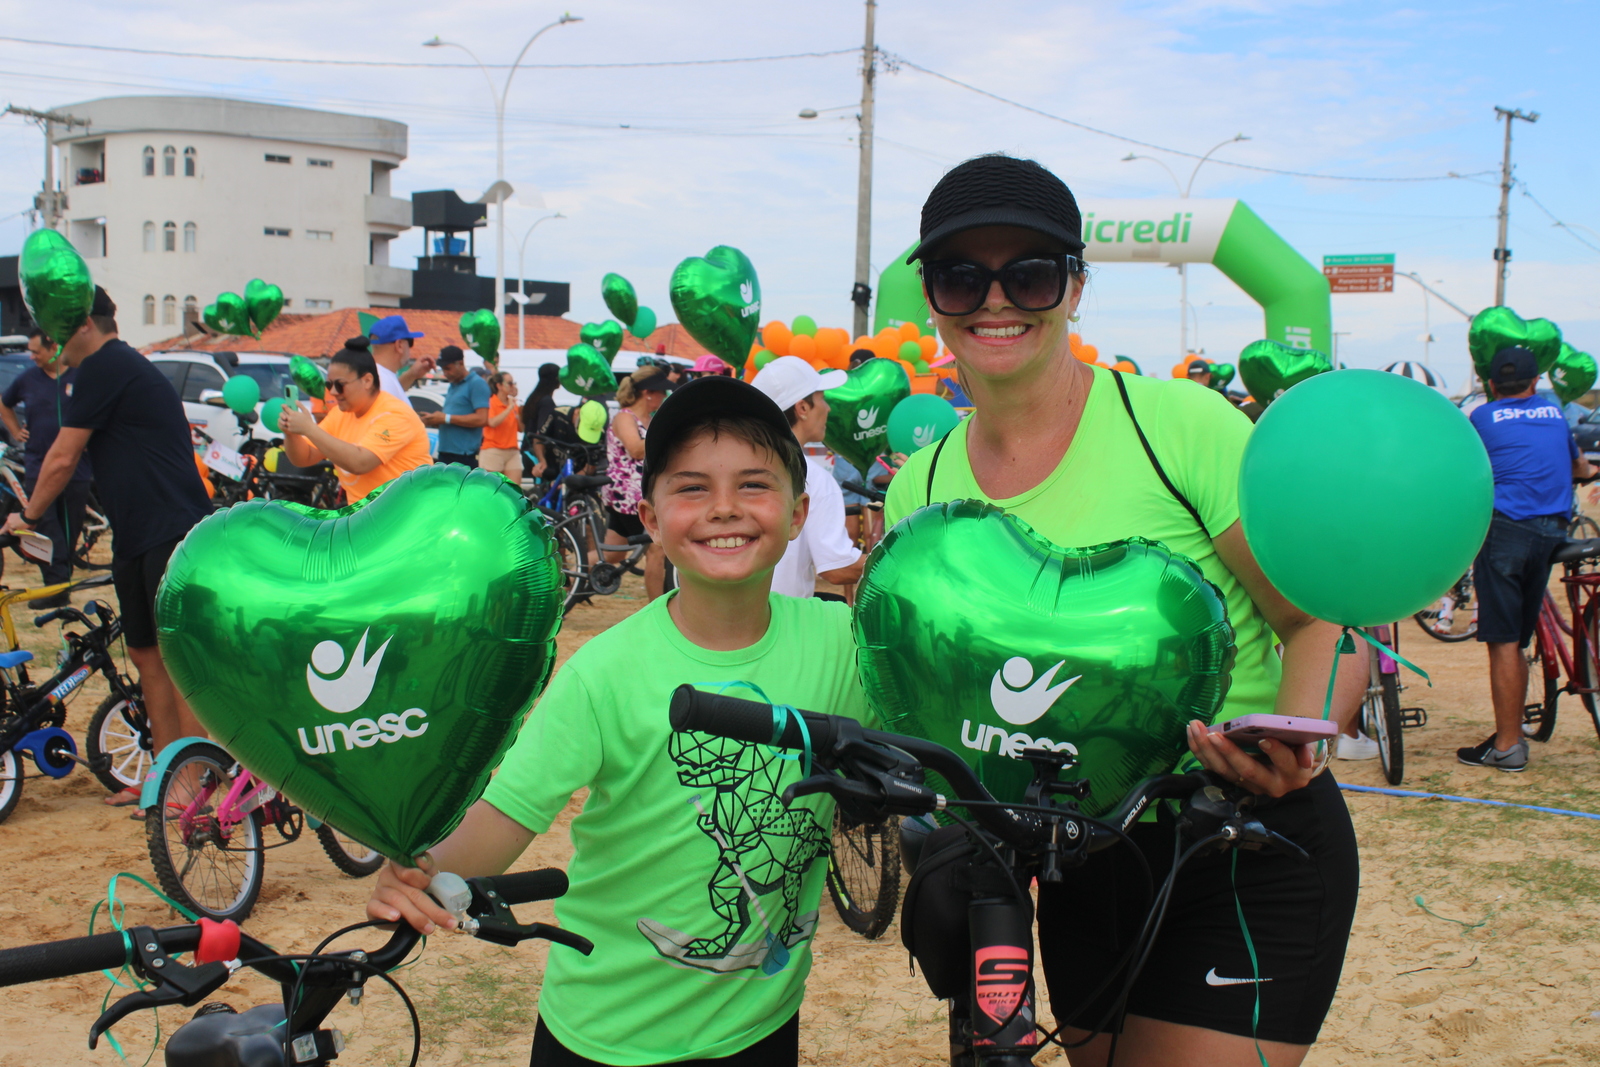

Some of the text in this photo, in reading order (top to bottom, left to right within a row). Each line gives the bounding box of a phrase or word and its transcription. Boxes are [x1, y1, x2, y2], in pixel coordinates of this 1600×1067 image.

[1080, 212, 1193, 243] icredi
[853, 424, 888, 441] unesc
[54, 676, 76, 699] TECH
[297, 707, 429, 755] unesc
[893, 780, 922, 794] SHIMANO
[1121, 795, 1147, 832] ABSOLUTE
